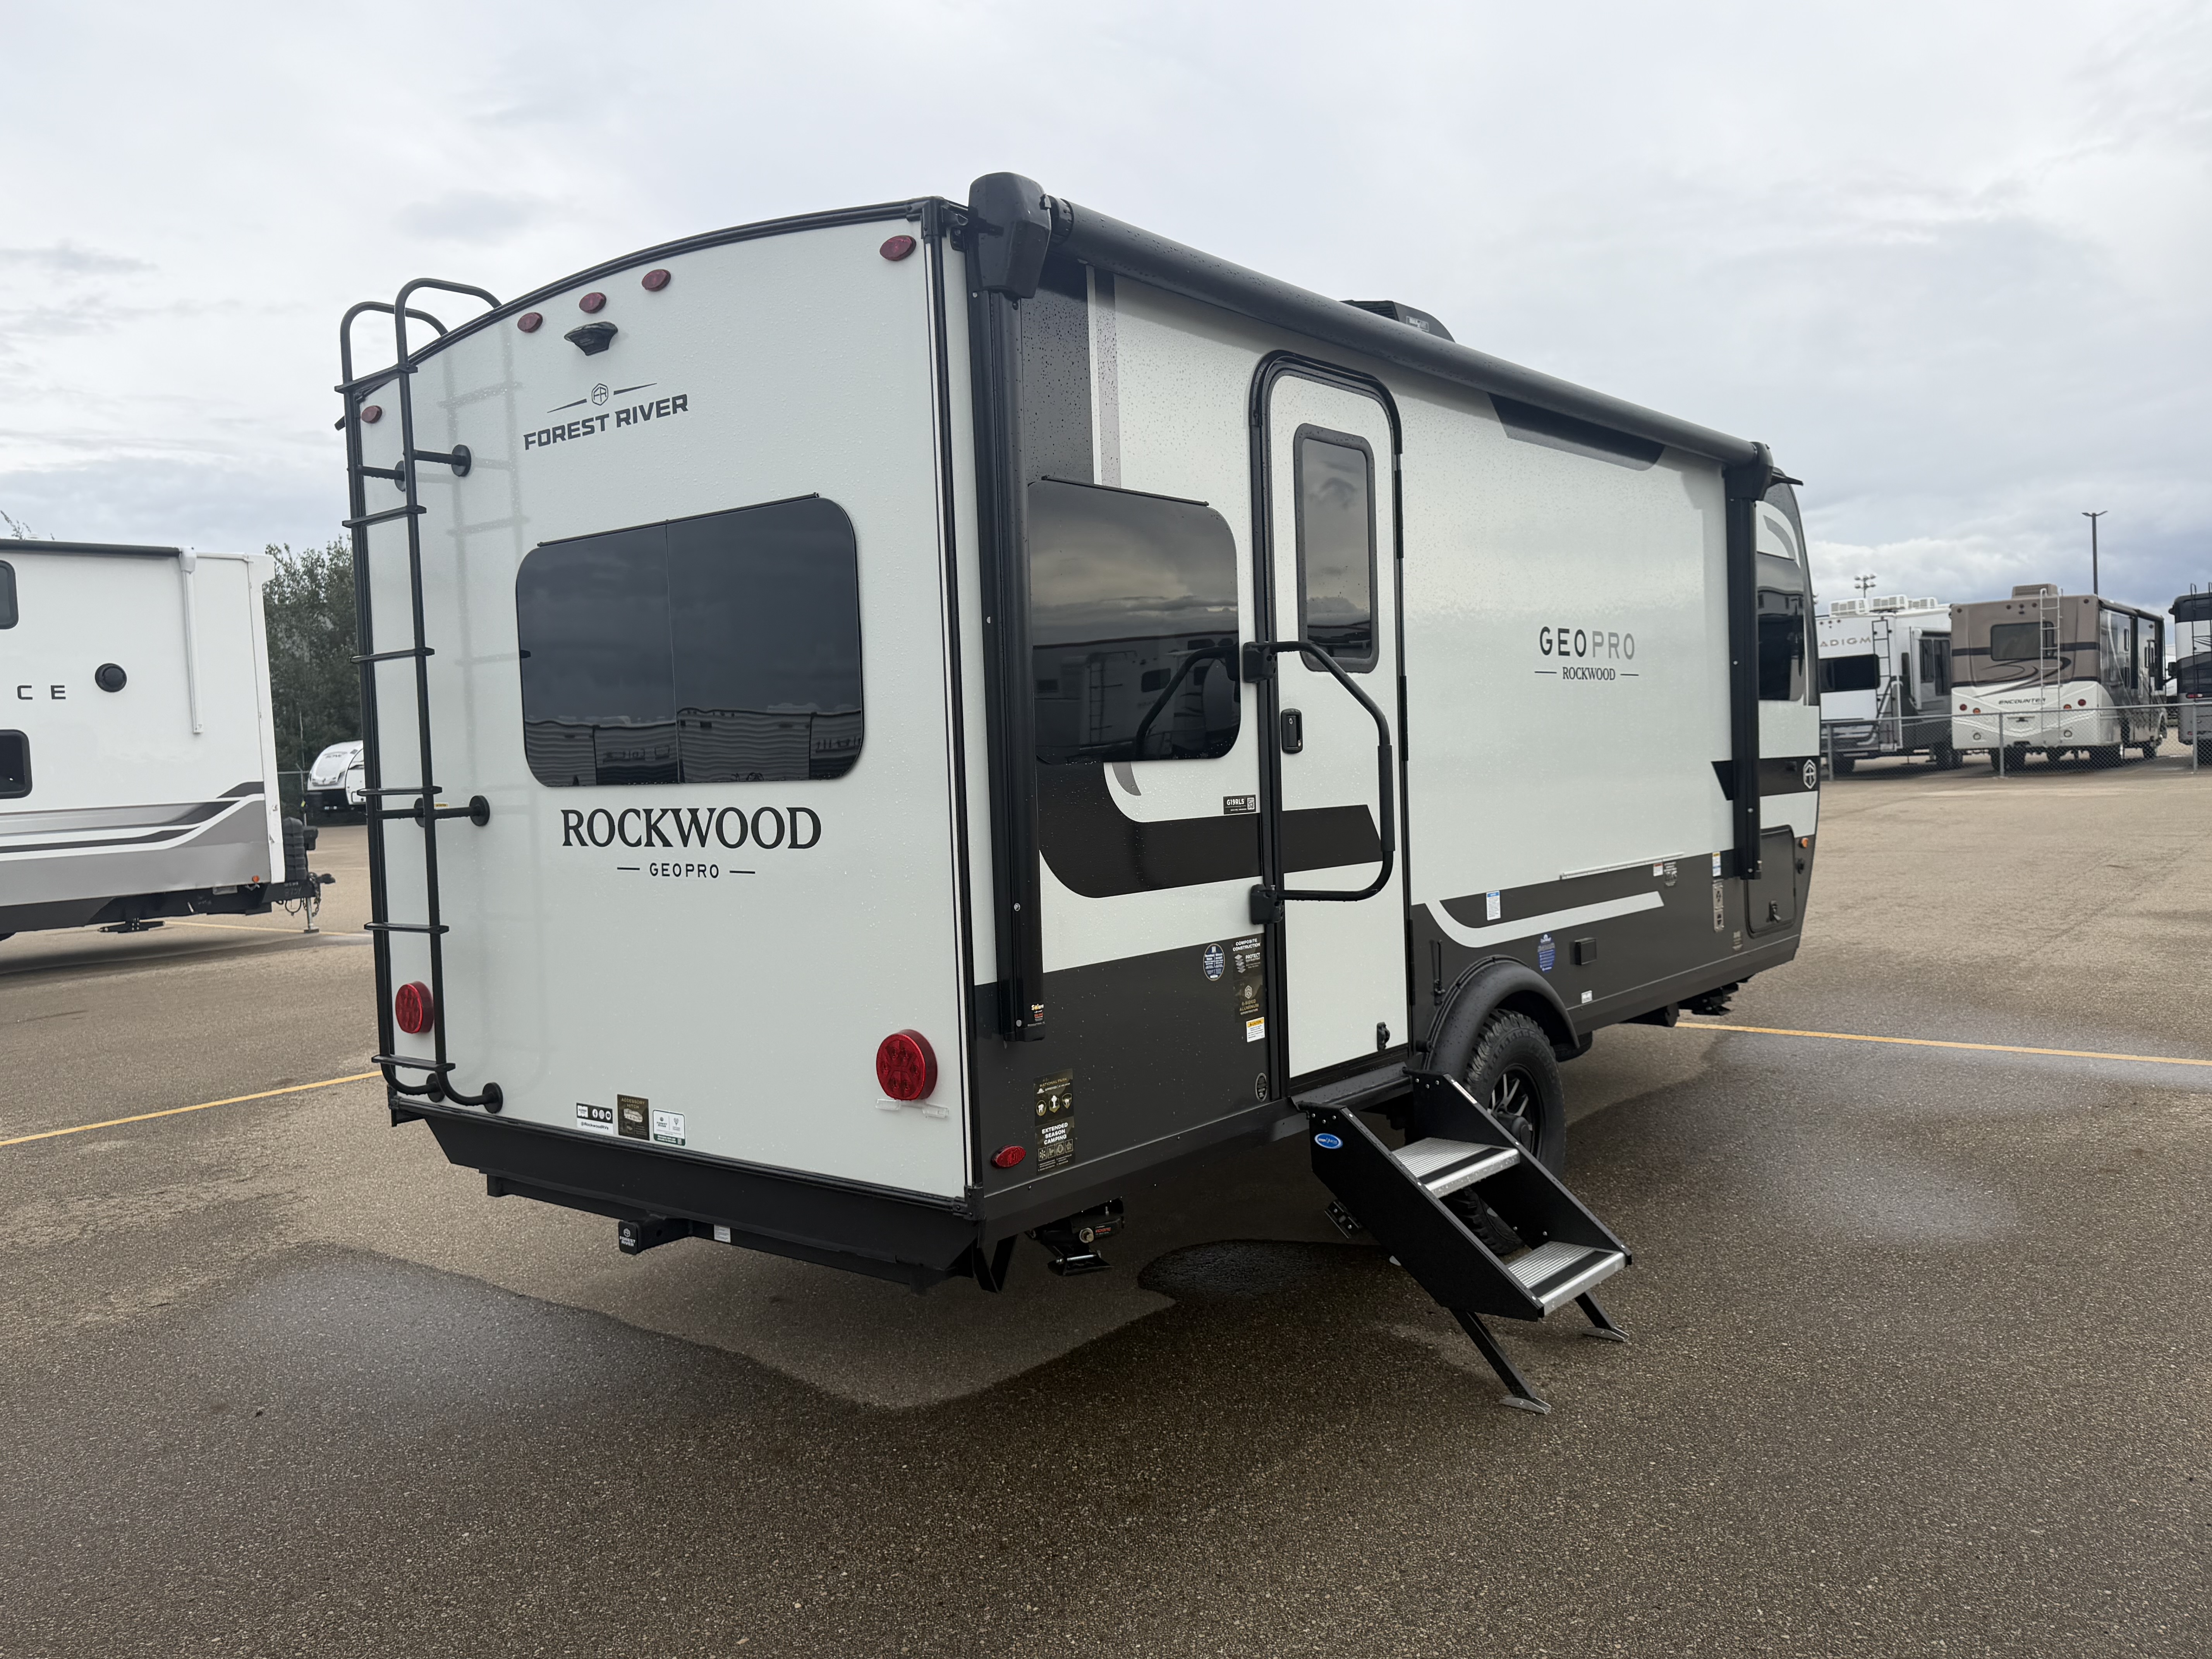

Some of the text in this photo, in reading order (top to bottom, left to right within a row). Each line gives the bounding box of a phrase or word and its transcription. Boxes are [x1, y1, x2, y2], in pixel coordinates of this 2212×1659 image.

[523, 394, 689, 450] FOREST RIVER
[1539, 626, 1635, 660] GEOPRO
[1562, 666, 1616, 680] ROCKWOOD
[561, 806, 821, 849] ROCKWOOD
[649, 862, 720, 879] GEOPRO
[1233, 942, 1261, 951] CONSTRUCTION
[1042, 1122, 1068, 1134] EXTENDED
[1045, 1129, 1065, 1139] SEASON
[1044, 1136, 1067, 1145] CAMPING
